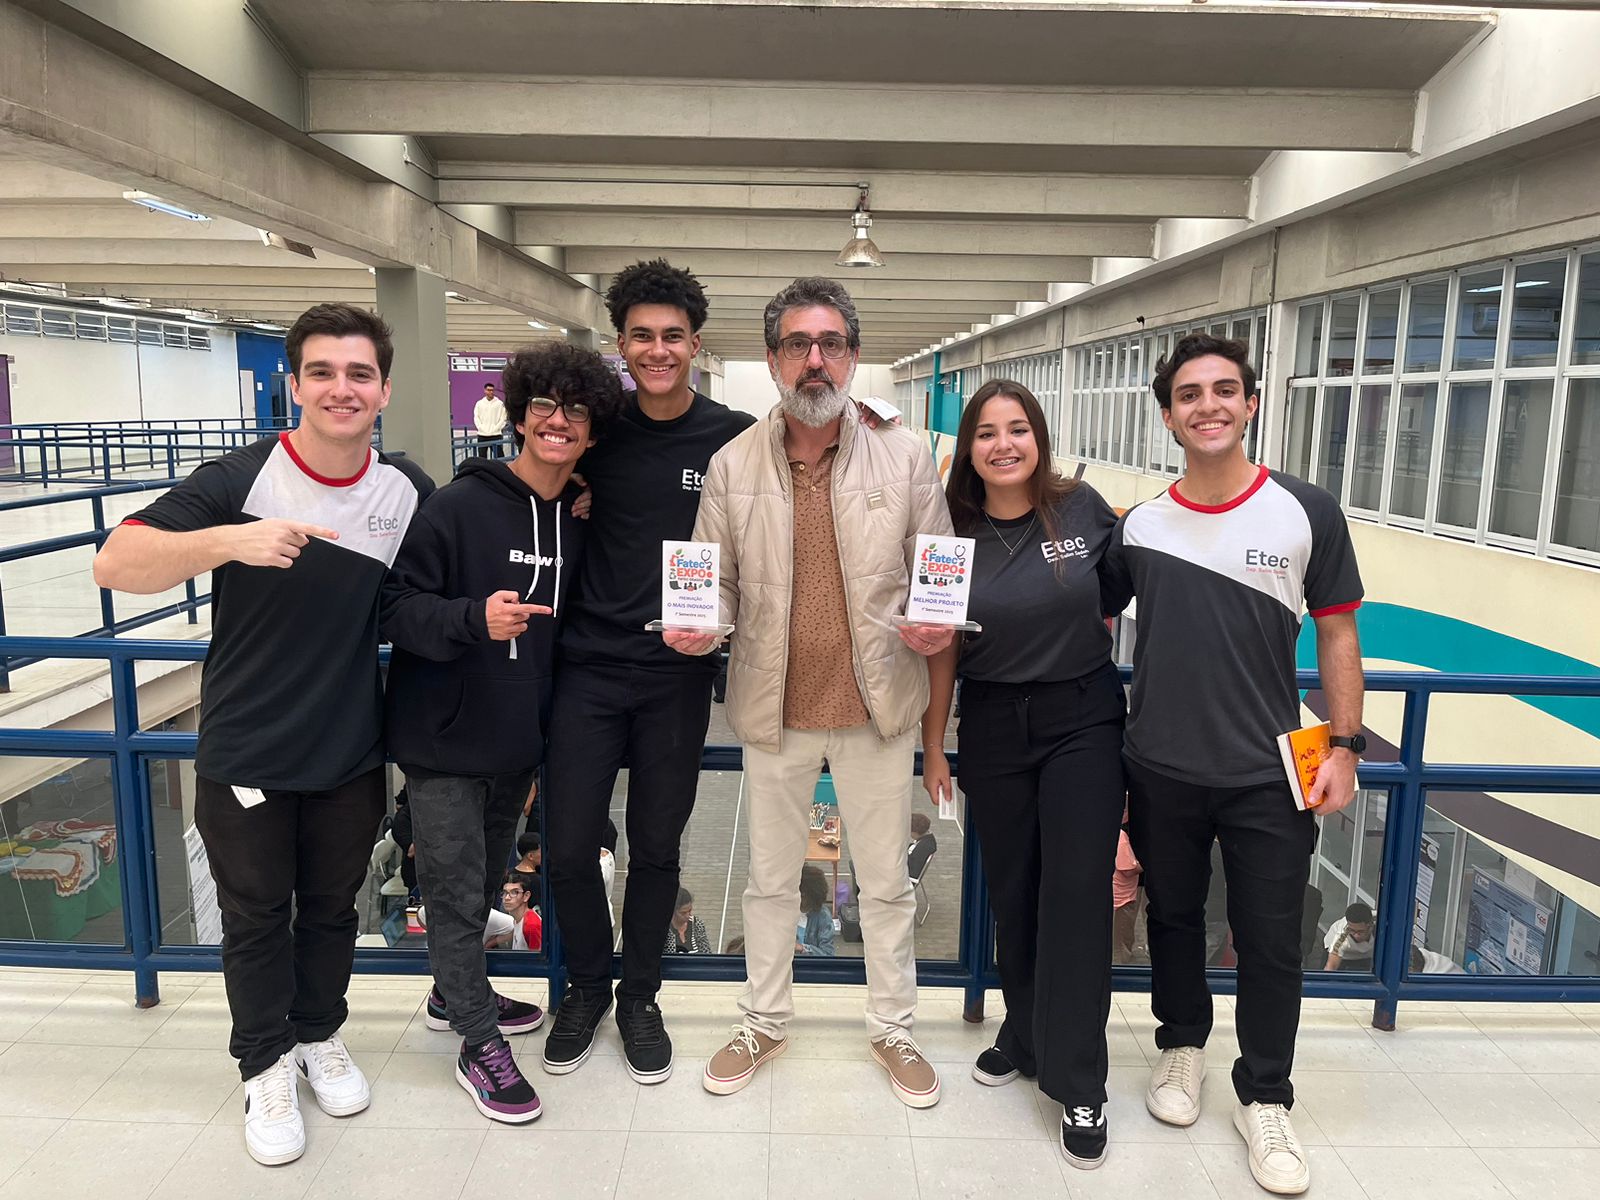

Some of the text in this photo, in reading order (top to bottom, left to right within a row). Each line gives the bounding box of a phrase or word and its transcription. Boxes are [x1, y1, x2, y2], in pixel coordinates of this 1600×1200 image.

[368, 515, 398, 532] Etec
[1041, 536, 1085, 559] Etec
[509, 549, 554, 567] Baw
[677, 559, 706, 569] Fatec
[928, 553, 958, 565] Fatec
[1246, 549, 1289, 569] Etec
[677, 568, 706, 578] EXPO
[927, 562, 958, 574] EXPO
[913, 596, 964, 607] MELHOR PROJETO
